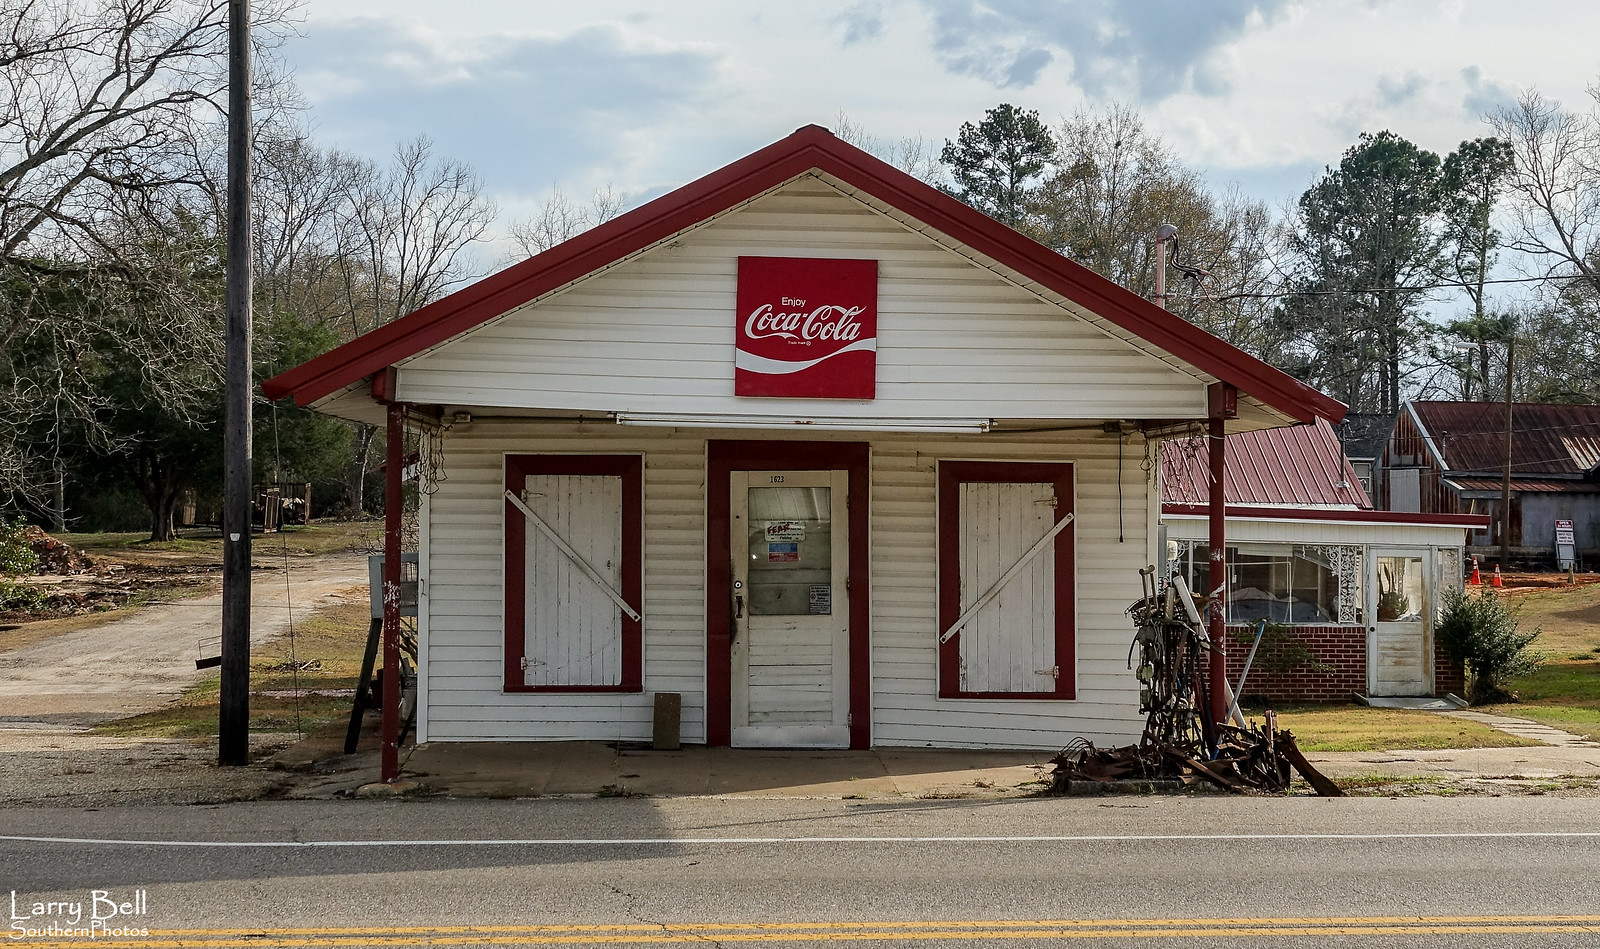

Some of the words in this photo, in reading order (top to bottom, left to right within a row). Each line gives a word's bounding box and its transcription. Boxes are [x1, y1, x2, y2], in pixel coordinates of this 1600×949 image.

[781, 296, 807, 307] Enjoy
[744, 303, 868, 341] Coca-Cola
[770, 475, 785, 483] 1623
